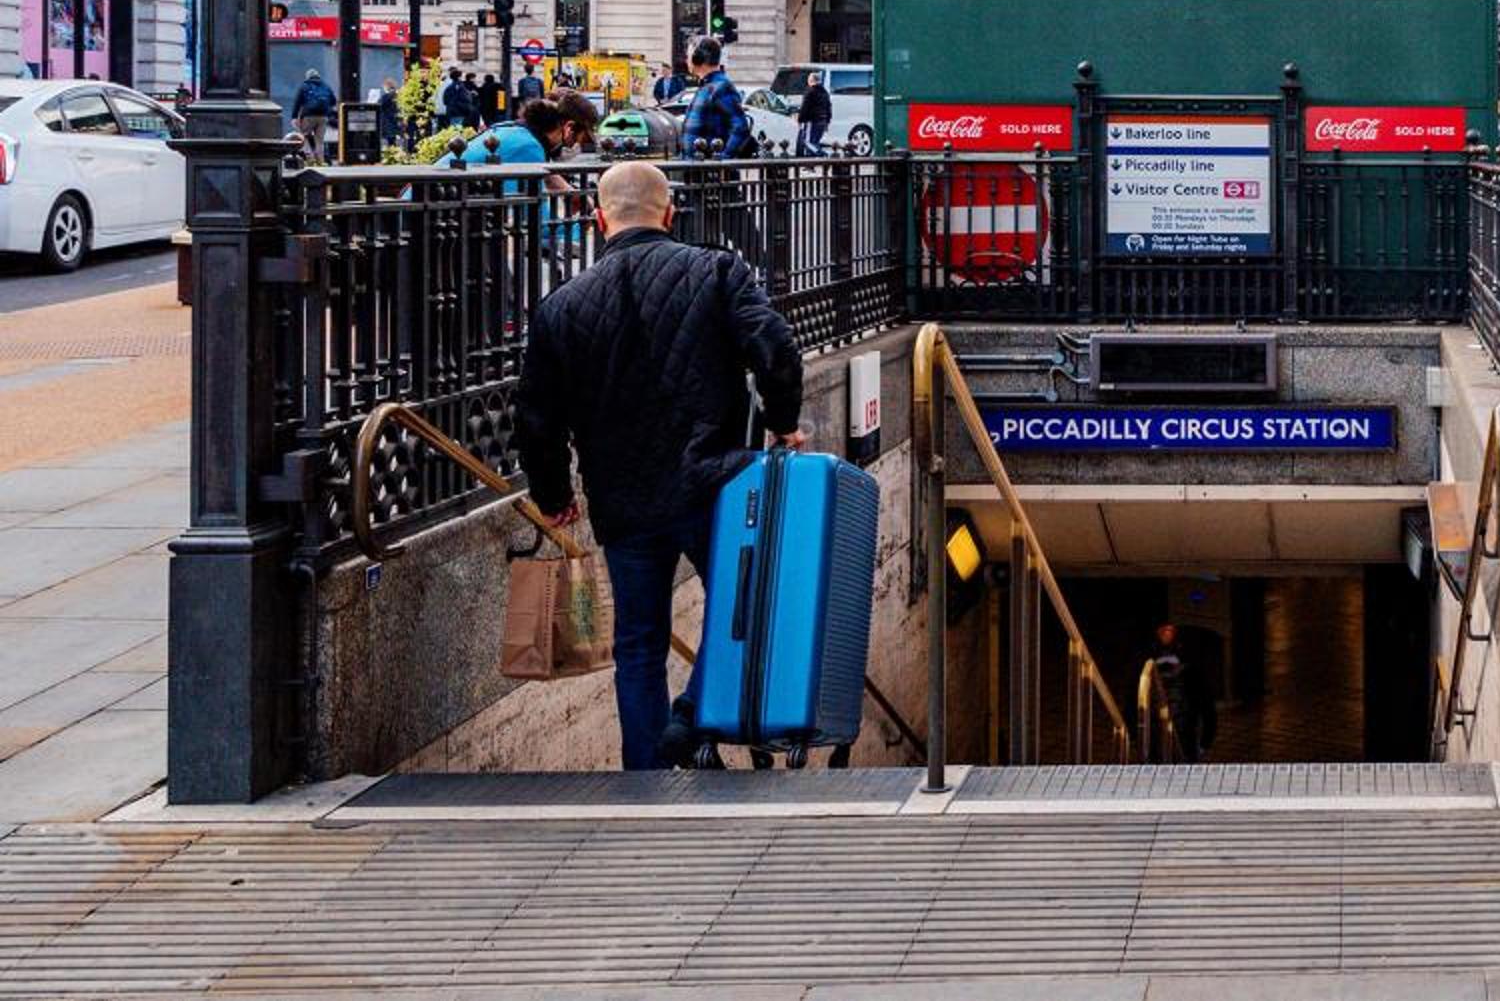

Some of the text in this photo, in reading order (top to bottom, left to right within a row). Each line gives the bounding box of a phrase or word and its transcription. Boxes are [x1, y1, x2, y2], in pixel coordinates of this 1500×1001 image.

[918, 115, 1063, 138] Coca-Cola SOLD HERE
[1125, 128, 1212, 140] Bakerloo line
[1315, 118, 1456, 141] Coca-Cola SOLD HERE
[1125, 159, 1216, 174] Piccadilly line
[1125, 183, 1219, 196] Visitor Centre
[1003, 418, 1152, 440] PICCADILLY
[1160, 418, 1255, 440] CIRCUS
[1262, 418, 1370, 440] STATION
